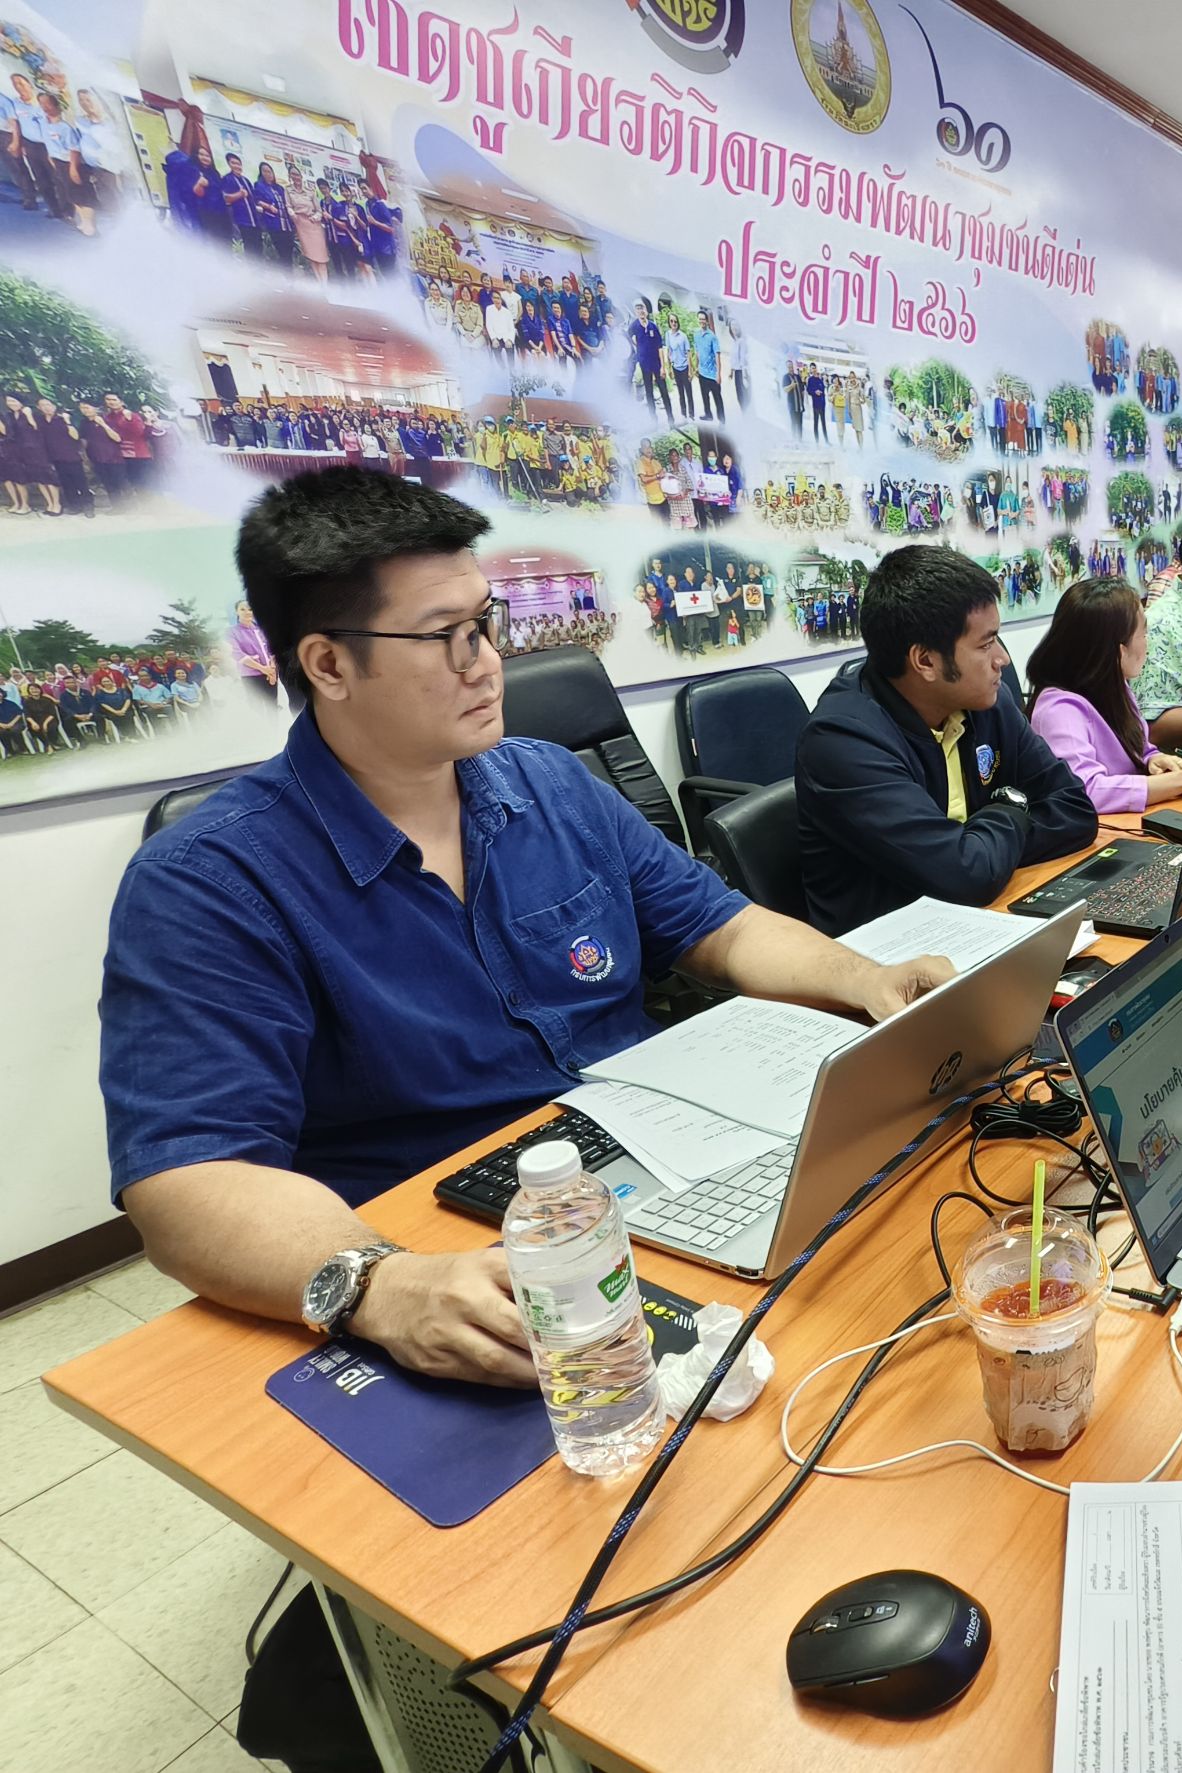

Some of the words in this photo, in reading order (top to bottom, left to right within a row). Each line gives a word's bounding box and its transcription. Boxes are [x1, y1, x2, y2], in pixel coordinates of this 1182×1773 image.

[717, 220, 881, 325] ประจำปี
[335, 1368, 386, 1396] JIB
[962, 1606, 979, 1648] anitech
